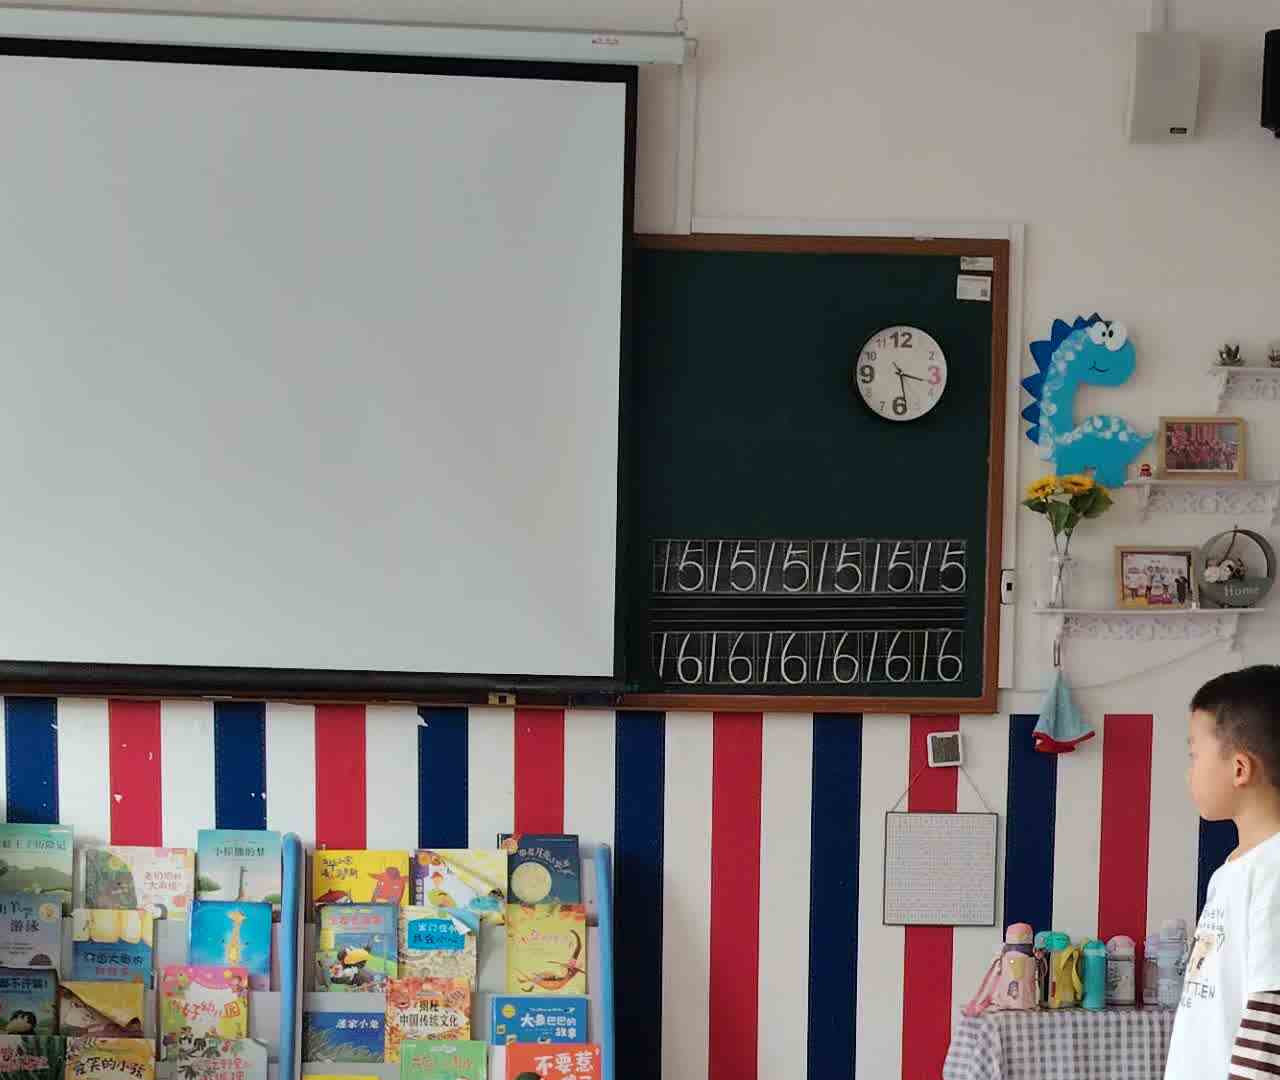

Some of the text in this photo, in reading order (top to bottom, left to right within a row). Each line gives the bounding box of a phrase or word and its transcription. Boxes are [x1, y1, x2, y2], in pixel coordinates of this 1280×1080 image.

[889, 331, 913, 348] 12
[866, 351, 877, 361] 10
[861, 365, 875, 384] 9
[928, 367, 941, 385] 3
[892, 396, 908, 415] 6
[662, 540, 967, 592] 15 15 15 15 15 15
[1223, 584, 1261, 597] Home
[658, 631, 962, 684] 16 16 16 16 16 16
[399, 1013, 459, 1028] 中国传统文化
[534, 1050, 593, 1076] 不要惹
